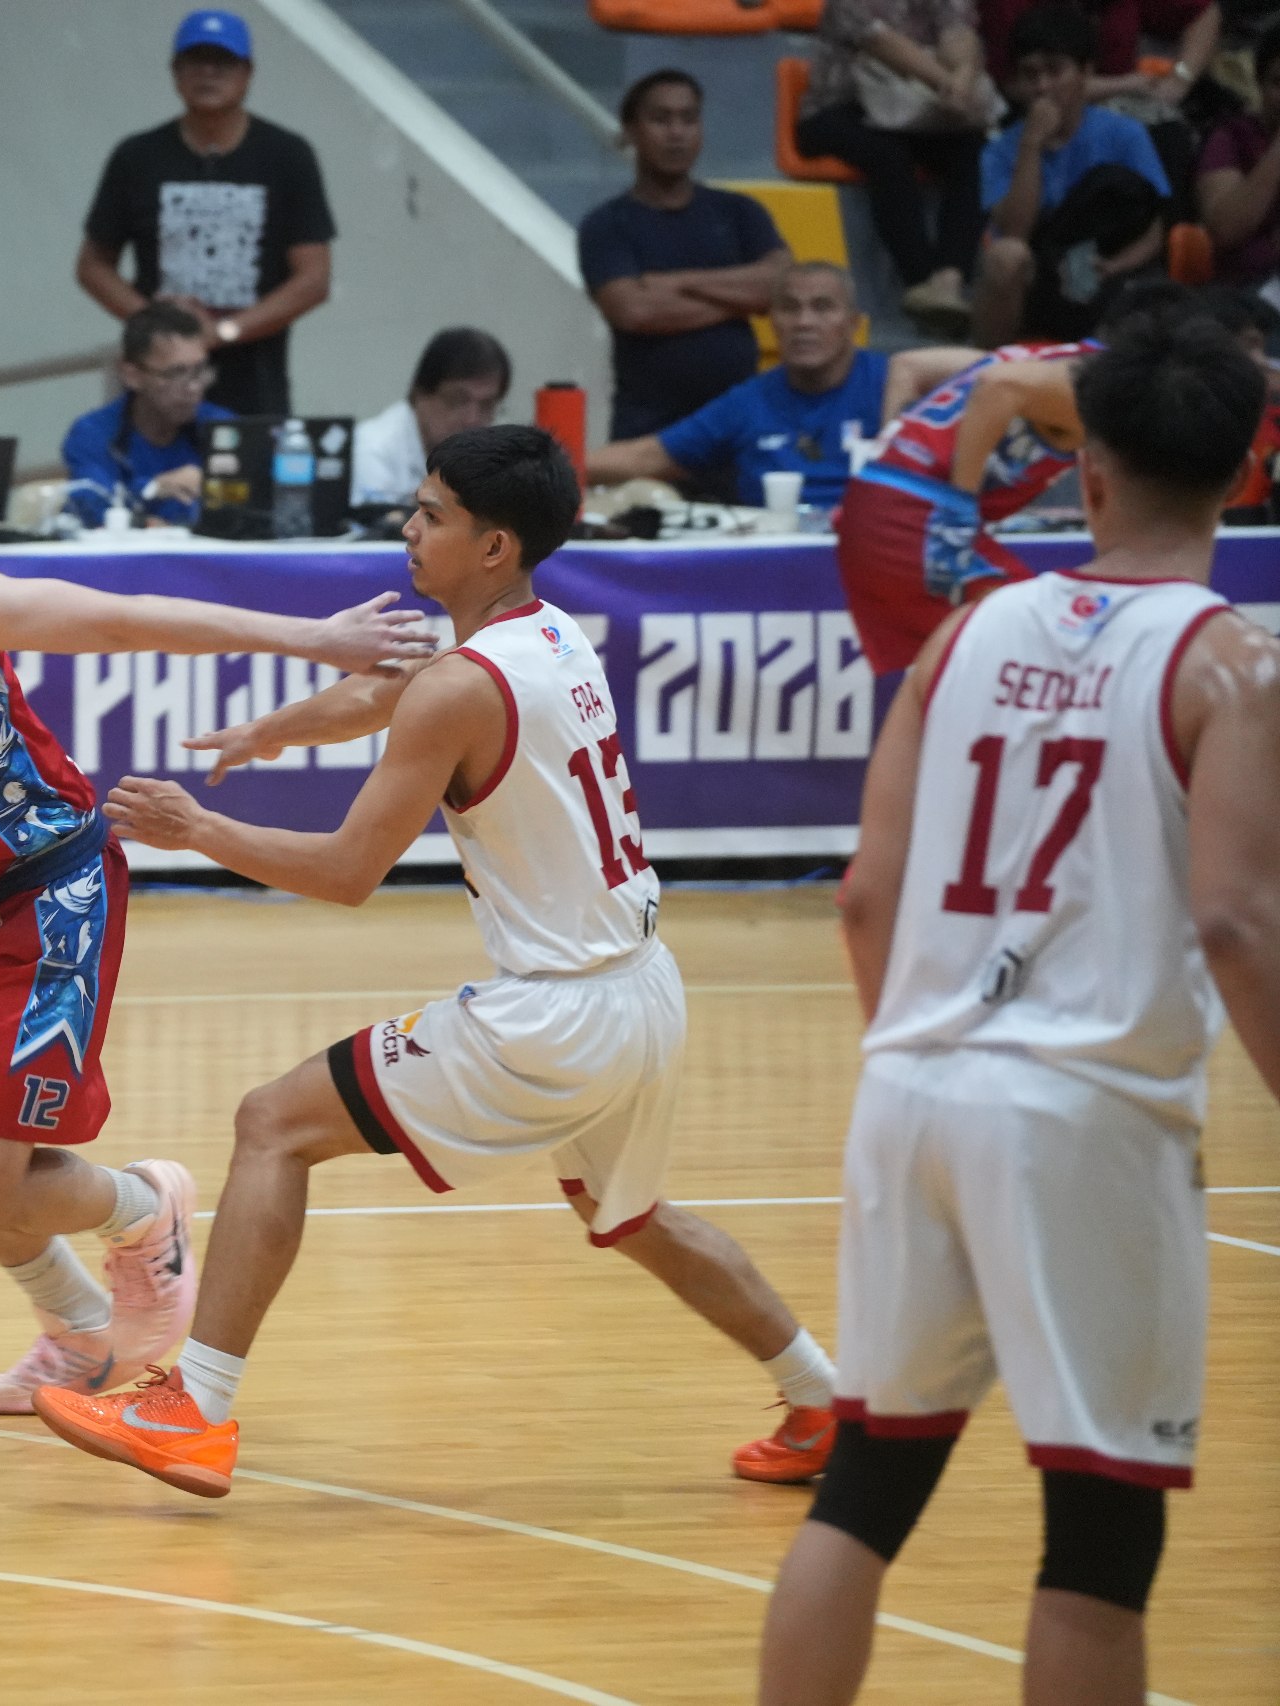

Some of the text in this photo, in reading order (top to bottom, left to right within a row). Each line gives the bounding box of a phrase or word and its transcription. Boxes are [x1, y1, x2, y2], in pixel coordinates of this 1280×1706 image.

[635, 610, 876, 762] 2026
[942, 733, 1106, 917] 17
[18, 1073, 70, 1130] 12
